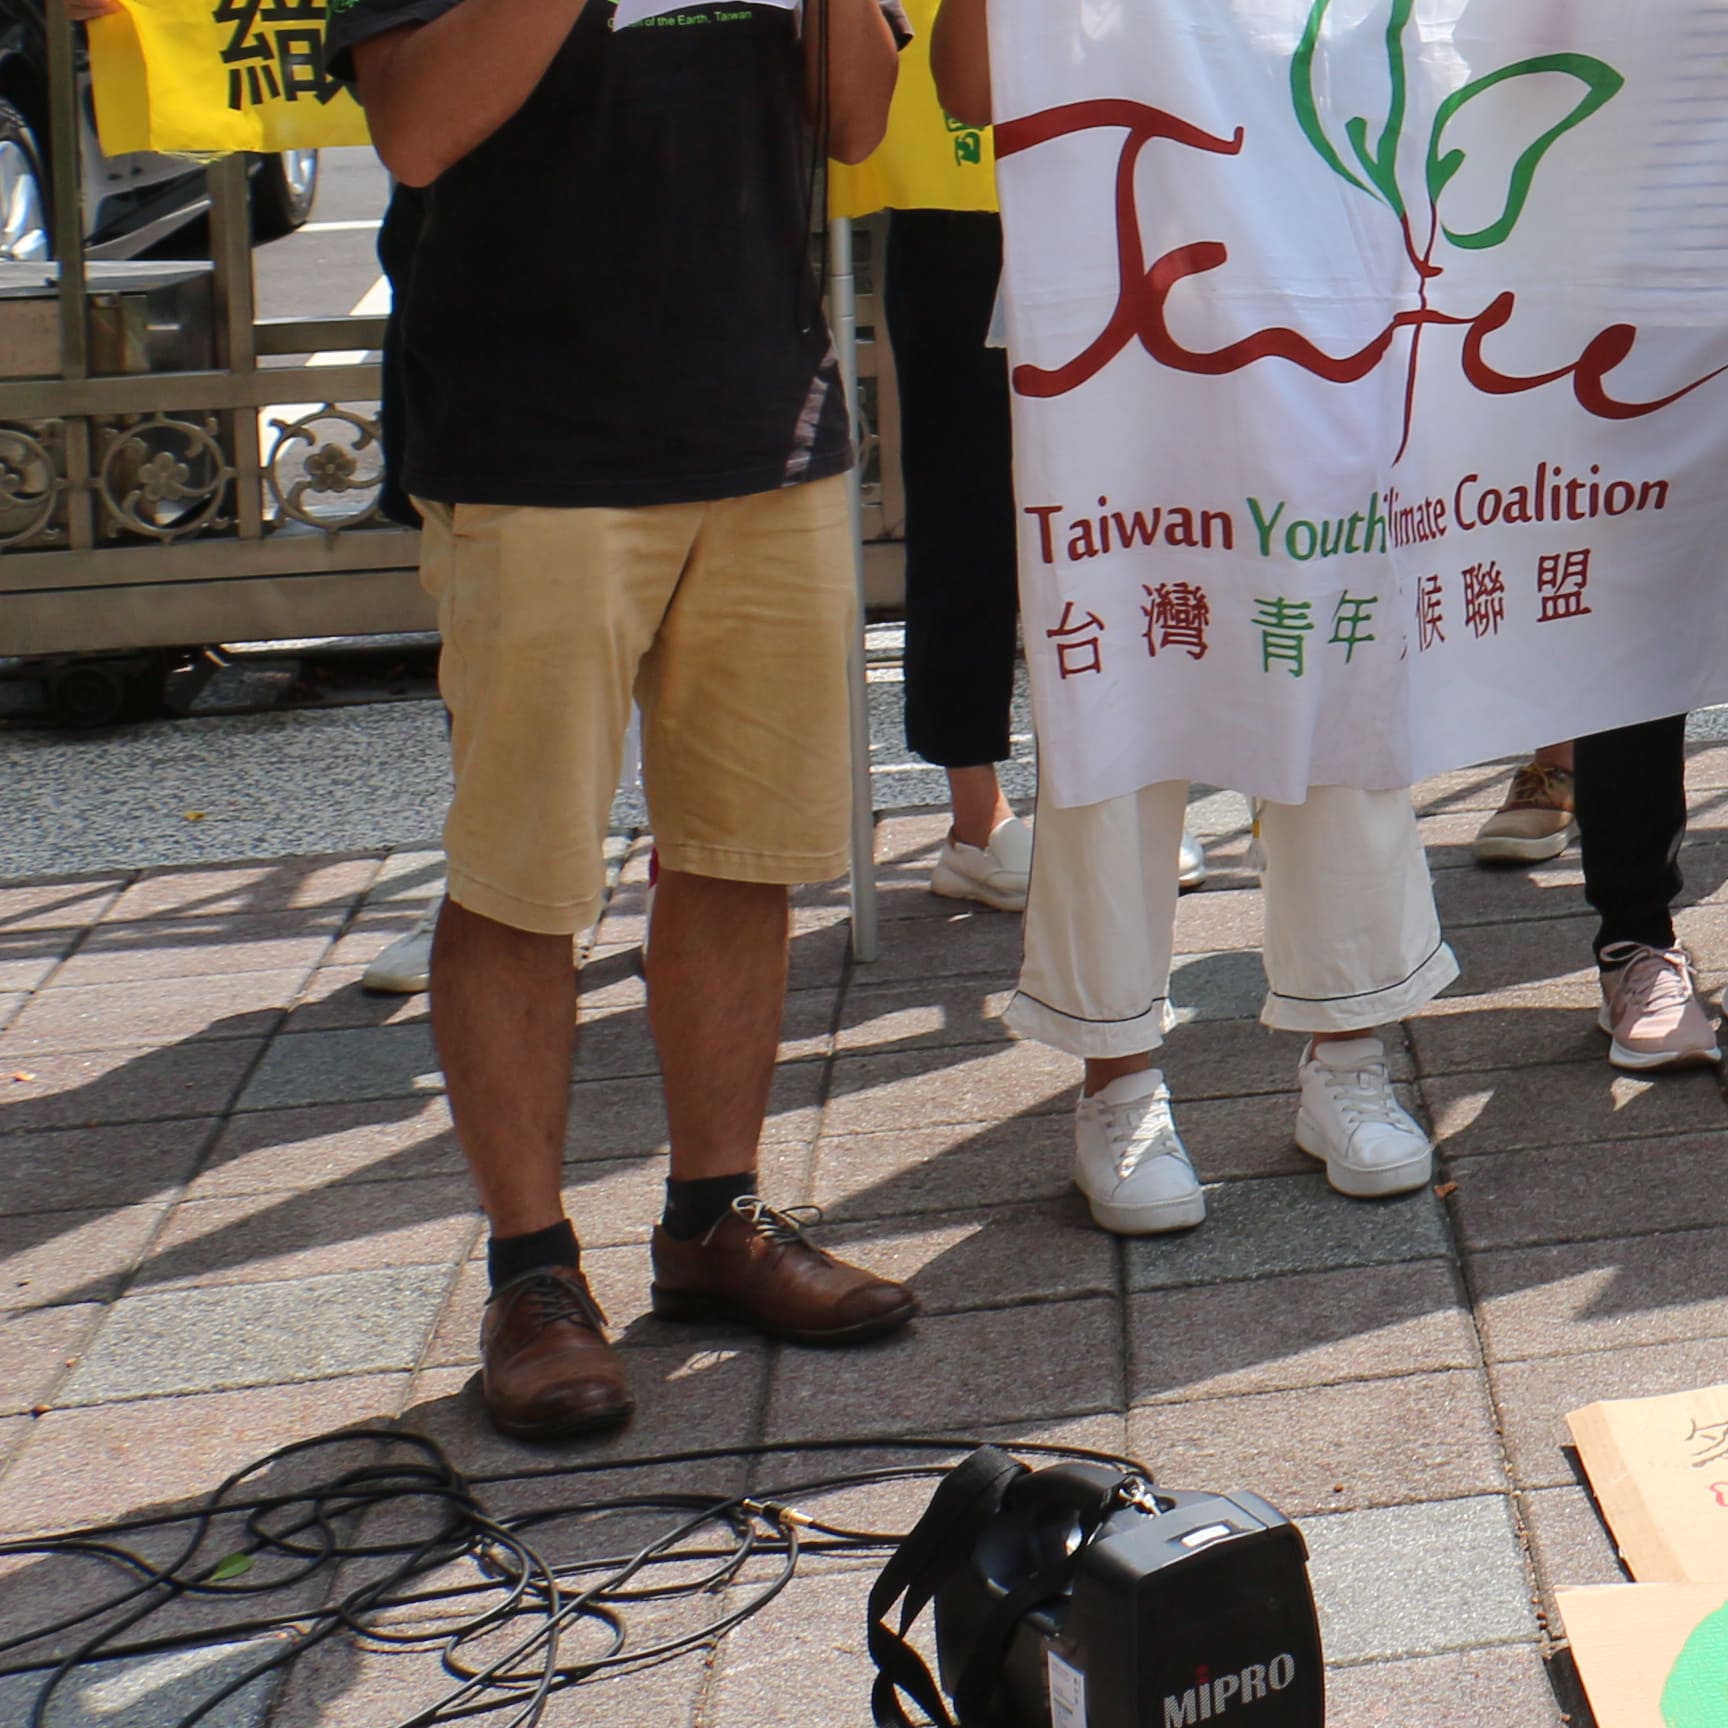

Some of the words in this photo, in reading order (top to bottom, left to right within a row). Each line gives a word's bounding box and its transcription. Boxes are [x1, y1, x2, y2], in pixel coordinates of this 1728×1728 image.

[713, 9, 752, 23] Taiwan
[1024, 496, 1234, 564] Taiwan
[1246, 491, 1388, 561] Youth
[1384, 486, 1447, 550] limate
[1452, 461, 1670, 532] Coalition
